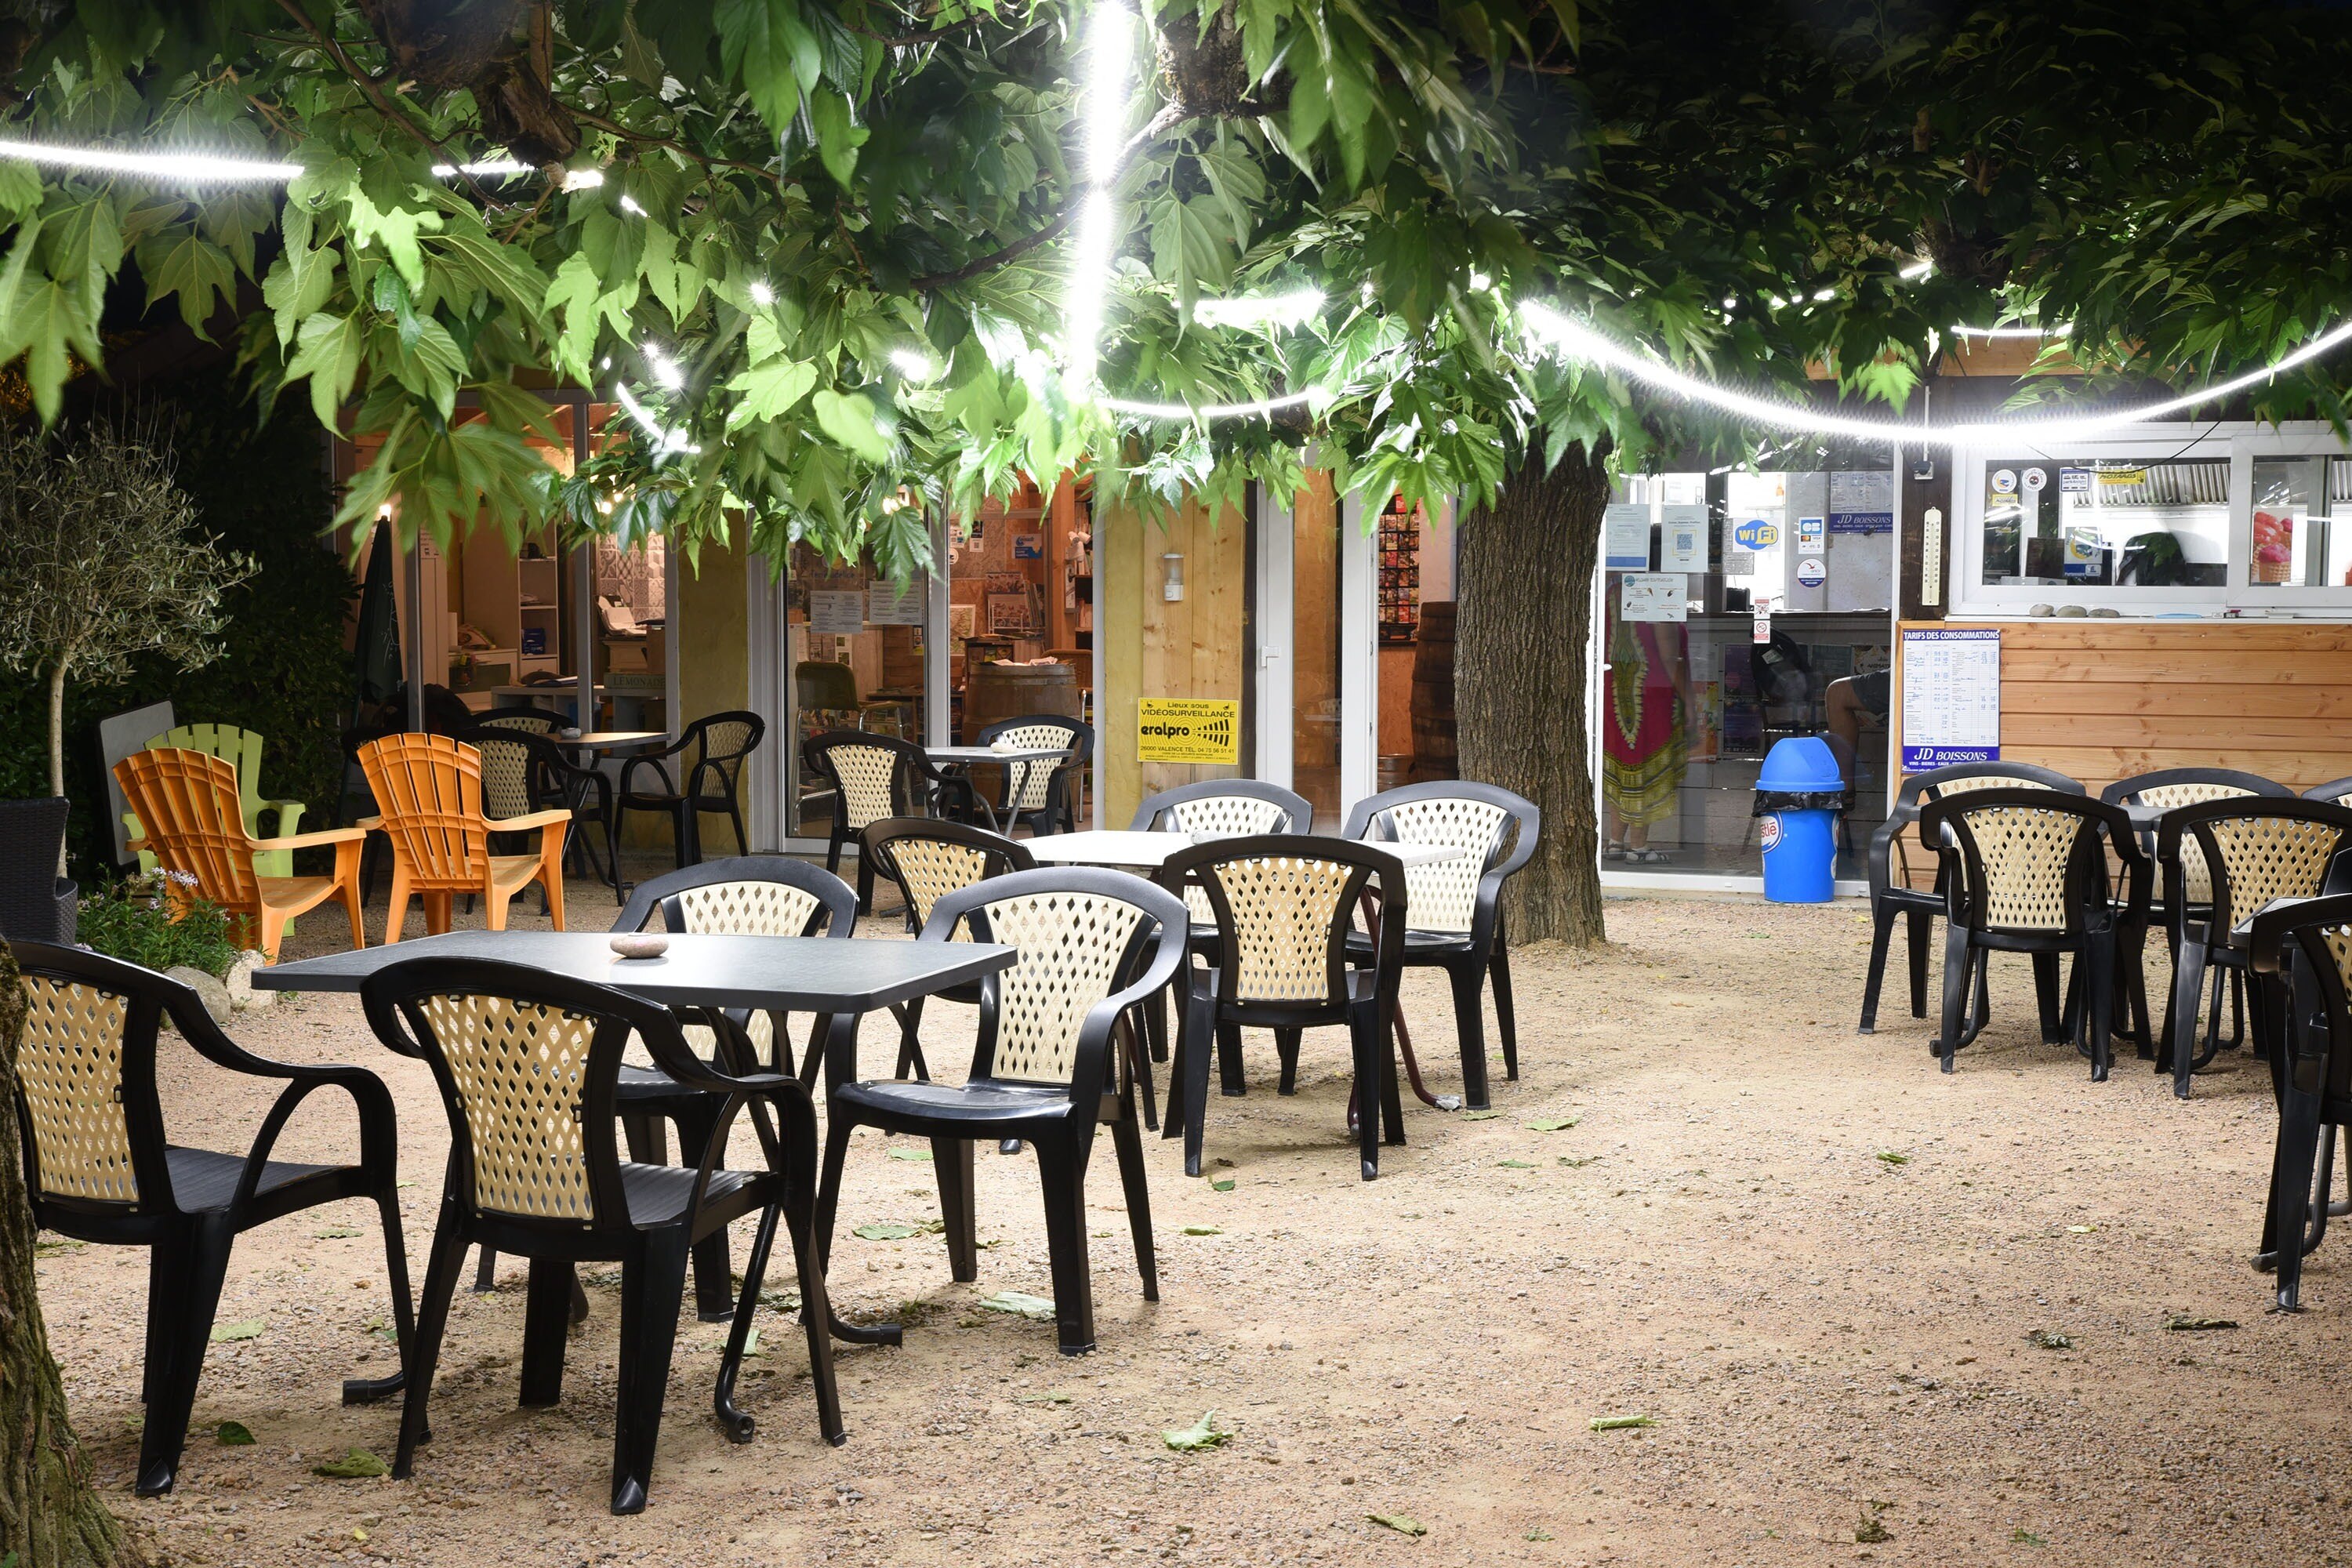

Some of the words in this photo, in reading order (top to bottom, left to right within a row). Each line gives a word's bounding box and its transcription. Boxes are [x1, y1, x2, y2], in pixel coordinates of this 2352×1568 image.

[1837, 514, 1852, 524] JD
[1940, 631, 1999, 640] CONSOMMATIONS
[1141, 708, 1235, 718] VIDÉOSURVEILLANCE
[1141, 721, 1190, 739] eralpro
[1914, 748, 1933, 760] JD
[1936, 752, 1987, 760] BOISSONS
